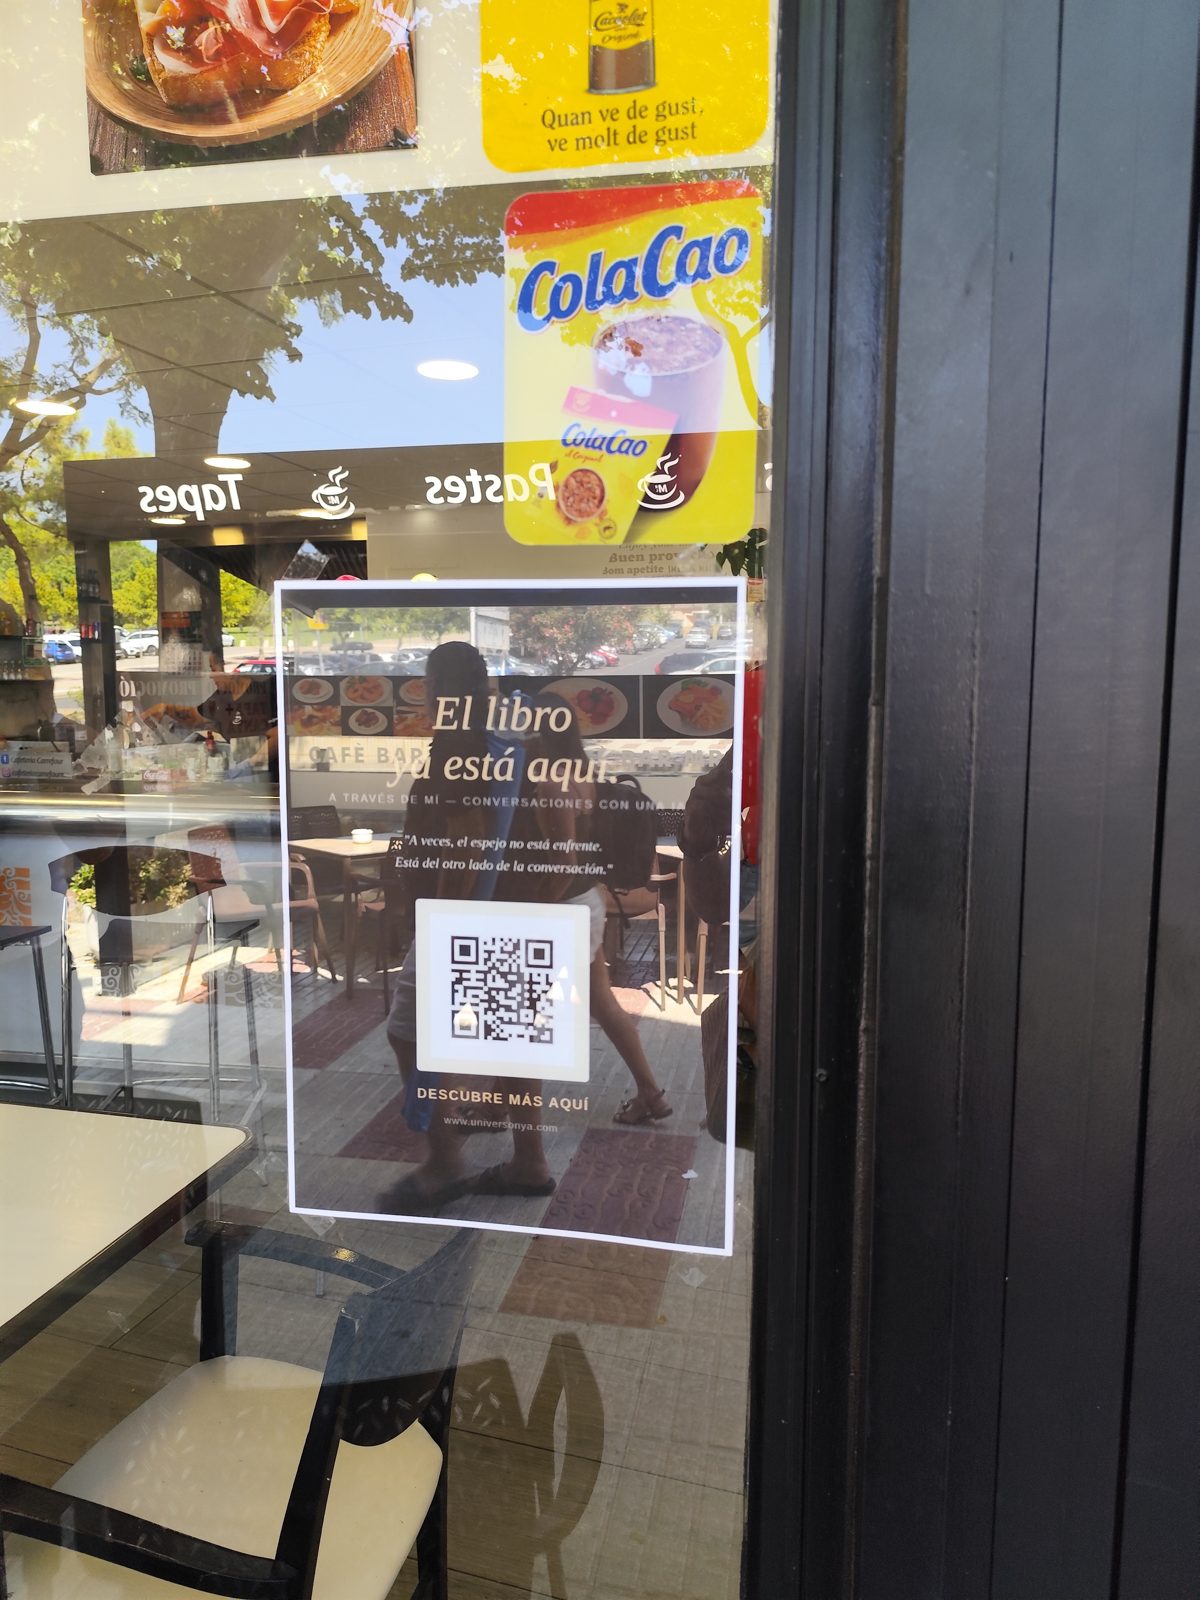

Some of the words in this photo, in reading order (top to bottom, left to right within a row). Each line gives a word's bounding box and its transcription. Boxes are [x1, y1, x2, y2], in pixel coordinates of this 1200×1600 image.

[541, 109, 592, 130] Quan
[599, 107, 620, 122] ve
[626, 99, 648, 120] de
[547, 138, 568, 152] ve
[575, 126, 620, 151] molt
[626, 125, 648, 145] de
[655, 122, 697, 147] gust
[516, 224, 750, 335] ColaCao
[560, 423, 648, 457] ColaCao
[608, 553, 645, 563] Buen
[627, 565, 664, 576] apetite
[432, 696, 472, 731] El
[485, 696, 572, 733] libro
[377, 747, 424, 764] BAR
[444, 747, 515, 782] está
[527, 750, 618, 792] aquí.
[328, 793, 337, 802] A
[343, 791, 395, 804] TRAVÉS
[400, 794, 418, 804] DE
[424, 793, 439, 805] MÍ
[462, 796, 593, 810] CONVERSACIONES
[599, 799, 630, 810] CON
[635, 801, 665, 810] UNA
[421, 837, 454, 848] veces,
[457, 836, 467, 848] el
[470, 837, 507, 851] espejo
[509, 840, 524, 850] no
[526, 838, 549, 850] está
[553, 840, 603, 853] enfrente.
[395, 856, 419, 868] Está
[422, 857, 439, 869] del
[442, 860, 466, 870] otro
[469, 859, 494, 871] lado
[496, 860, 510, 871] de
[513, 860, 524, 872] la
[527, 862, 614, 875] conversación."
[417, 1087, 502, 1104] DESCUBRE
[508, 1092, 543, 1107] MÁS
[549, 1096, 589, 1111] AQUÍ
[443, 1117, 558, 1133] www.universonya.com
